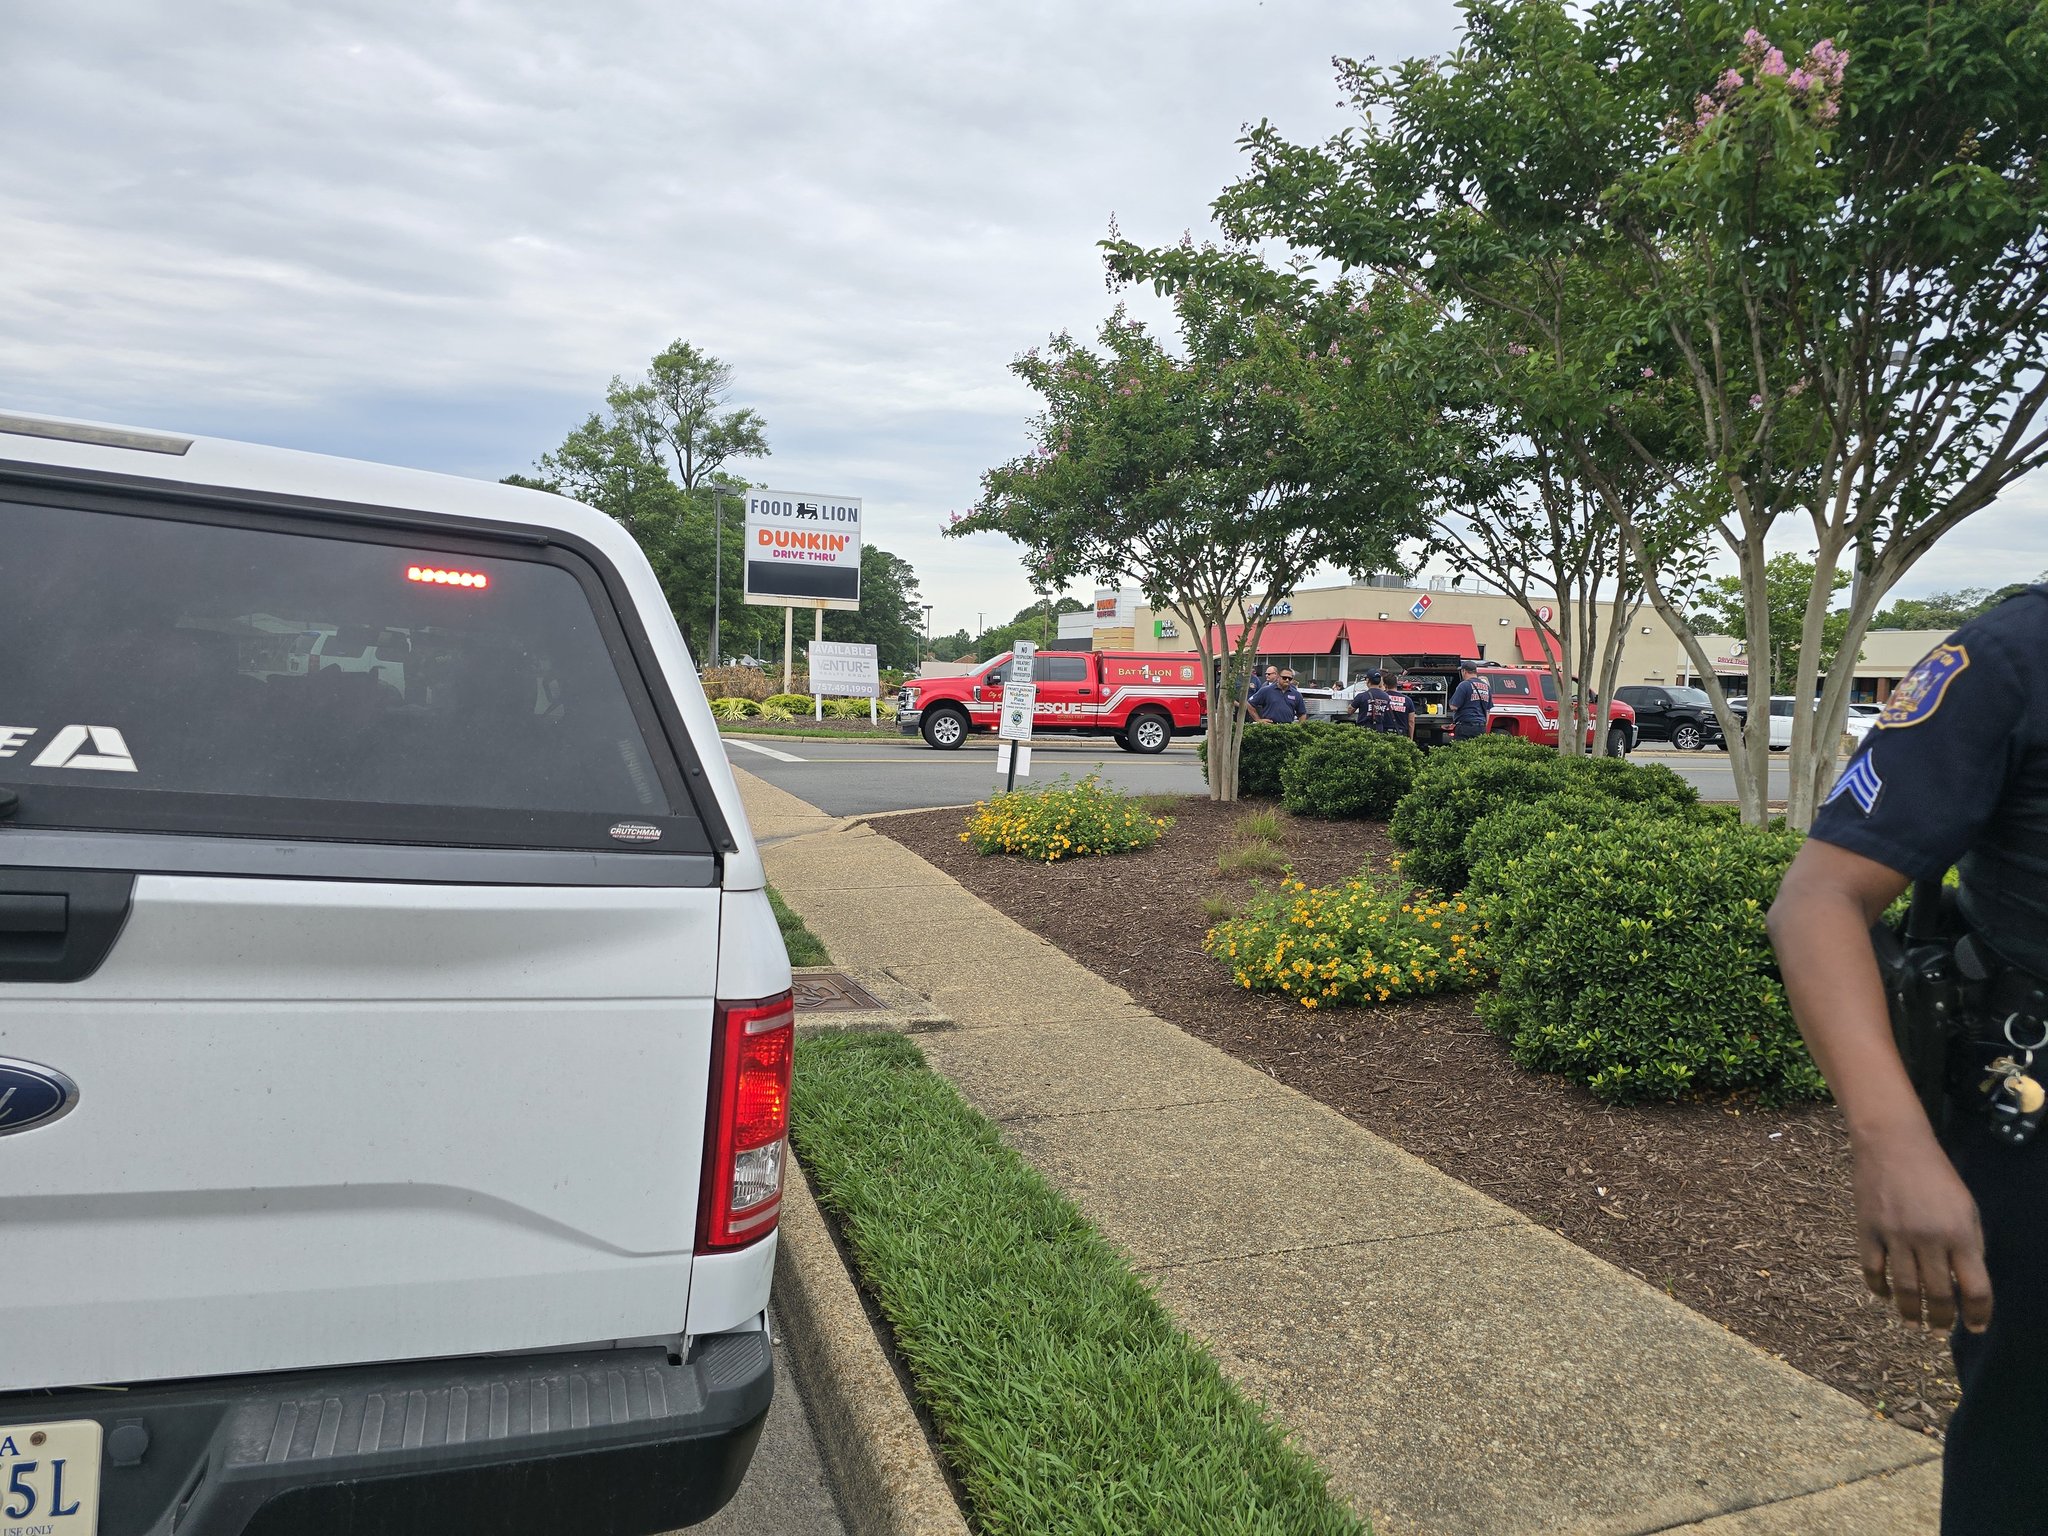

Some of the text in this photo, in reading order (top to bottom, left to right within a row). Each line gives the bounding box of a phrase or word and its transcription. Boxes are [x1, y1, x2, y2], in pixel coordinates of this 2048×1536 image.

[751, 499, 858, 523] FOOD LION
[758, 529, 850, 552] DUNKIN'
[773, 549, 836, 562] DRIVE THRU
[815, 645, 872, 656] AVAILABLE
[817, 660, 870, 673] VENTURE
[1141, 664, 1149, 679] 1
[816, 683, 873, 694] 757.491.1990
[610, 827, 662, 837] CRUTCHMAN
[3, 1525, 54, 1536] USE ONLY
